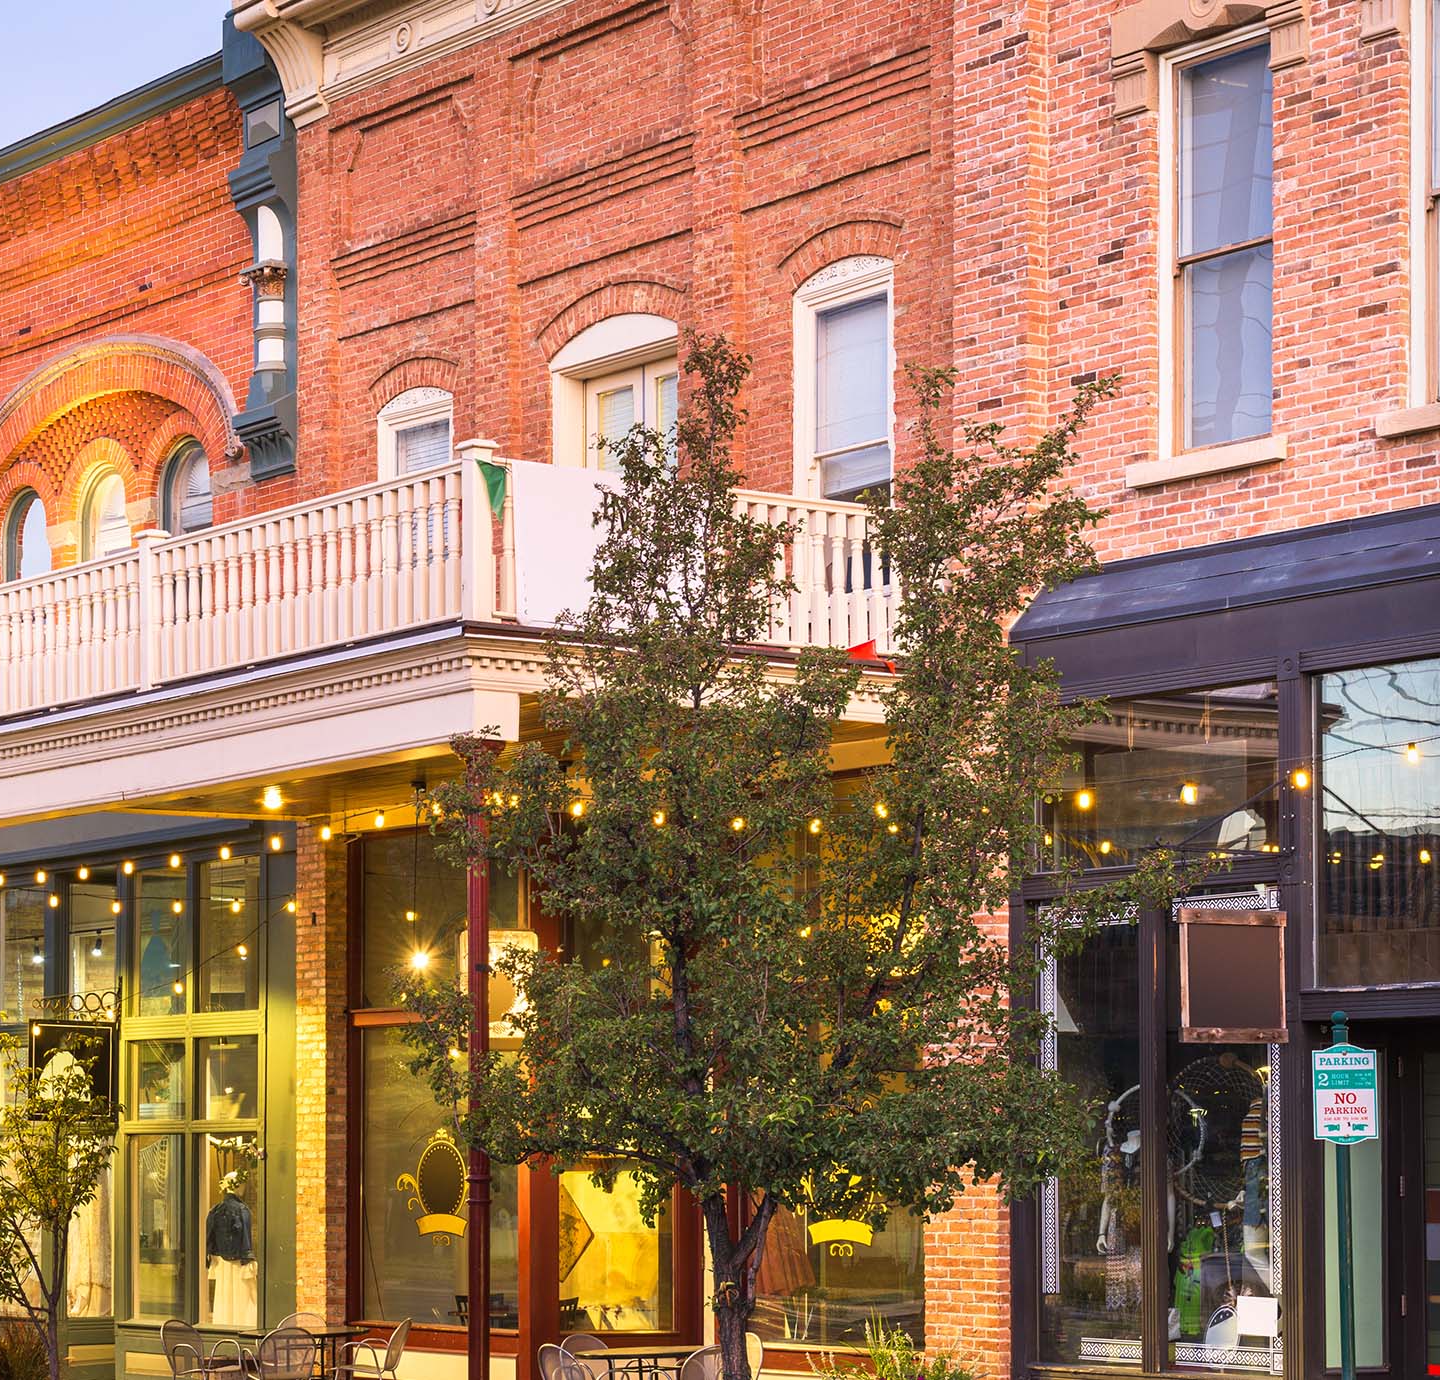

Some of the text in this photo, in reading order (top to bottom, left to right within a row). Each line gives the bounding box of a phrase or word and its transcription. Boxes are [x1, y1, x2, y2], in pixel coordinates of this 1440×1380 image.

[1319, 1057, 1369, 1066] PARKING
[1318, 1072, 1329, 1087] 2
[1334, 1092, 1357, 1104] NO
[1324, 1106, 1368, 1115] PARKING
